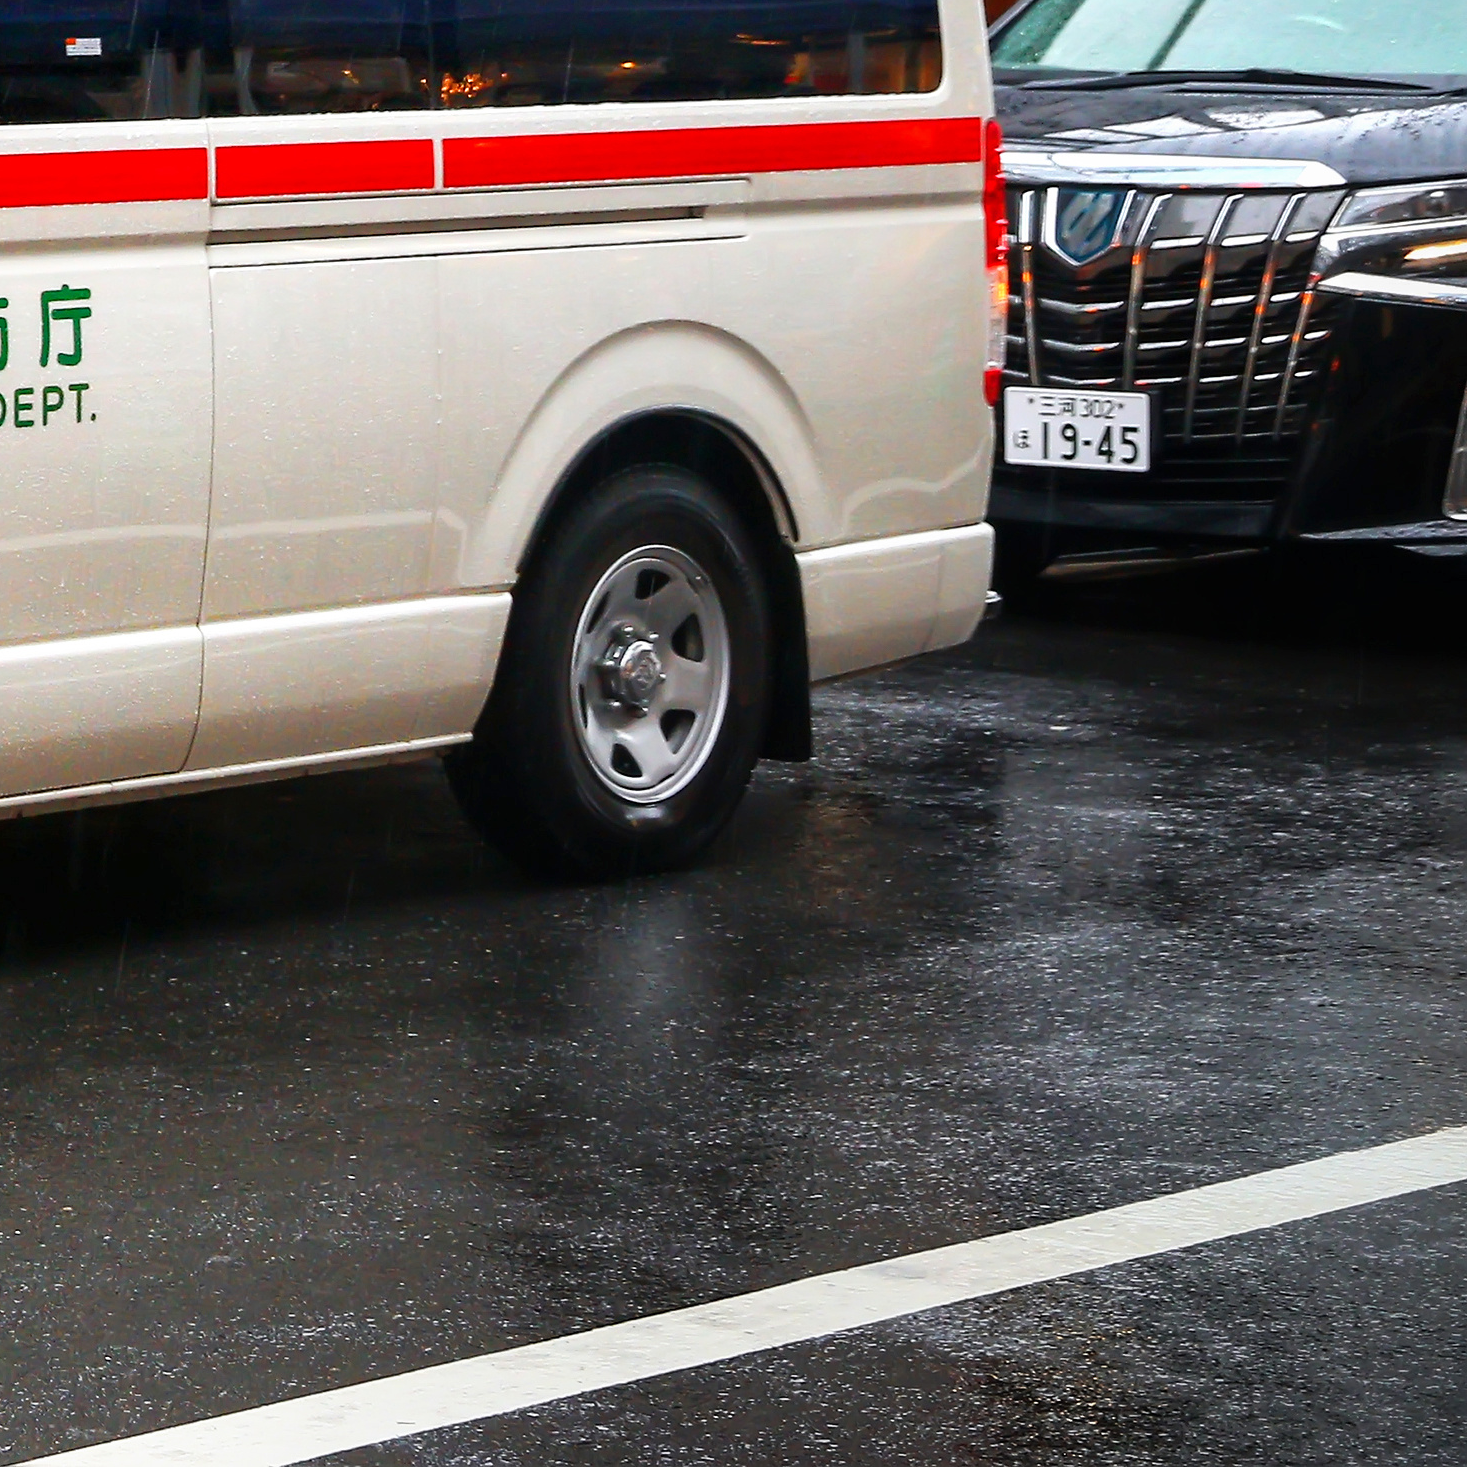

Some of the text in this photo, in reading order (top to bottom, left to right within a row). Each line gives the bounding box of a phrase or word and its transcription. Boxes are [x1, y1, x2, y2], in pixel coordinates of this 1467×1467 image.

[1038, 396, 1117, 420] 三河 302
[1041, 420, 1140, 464] 19-45
